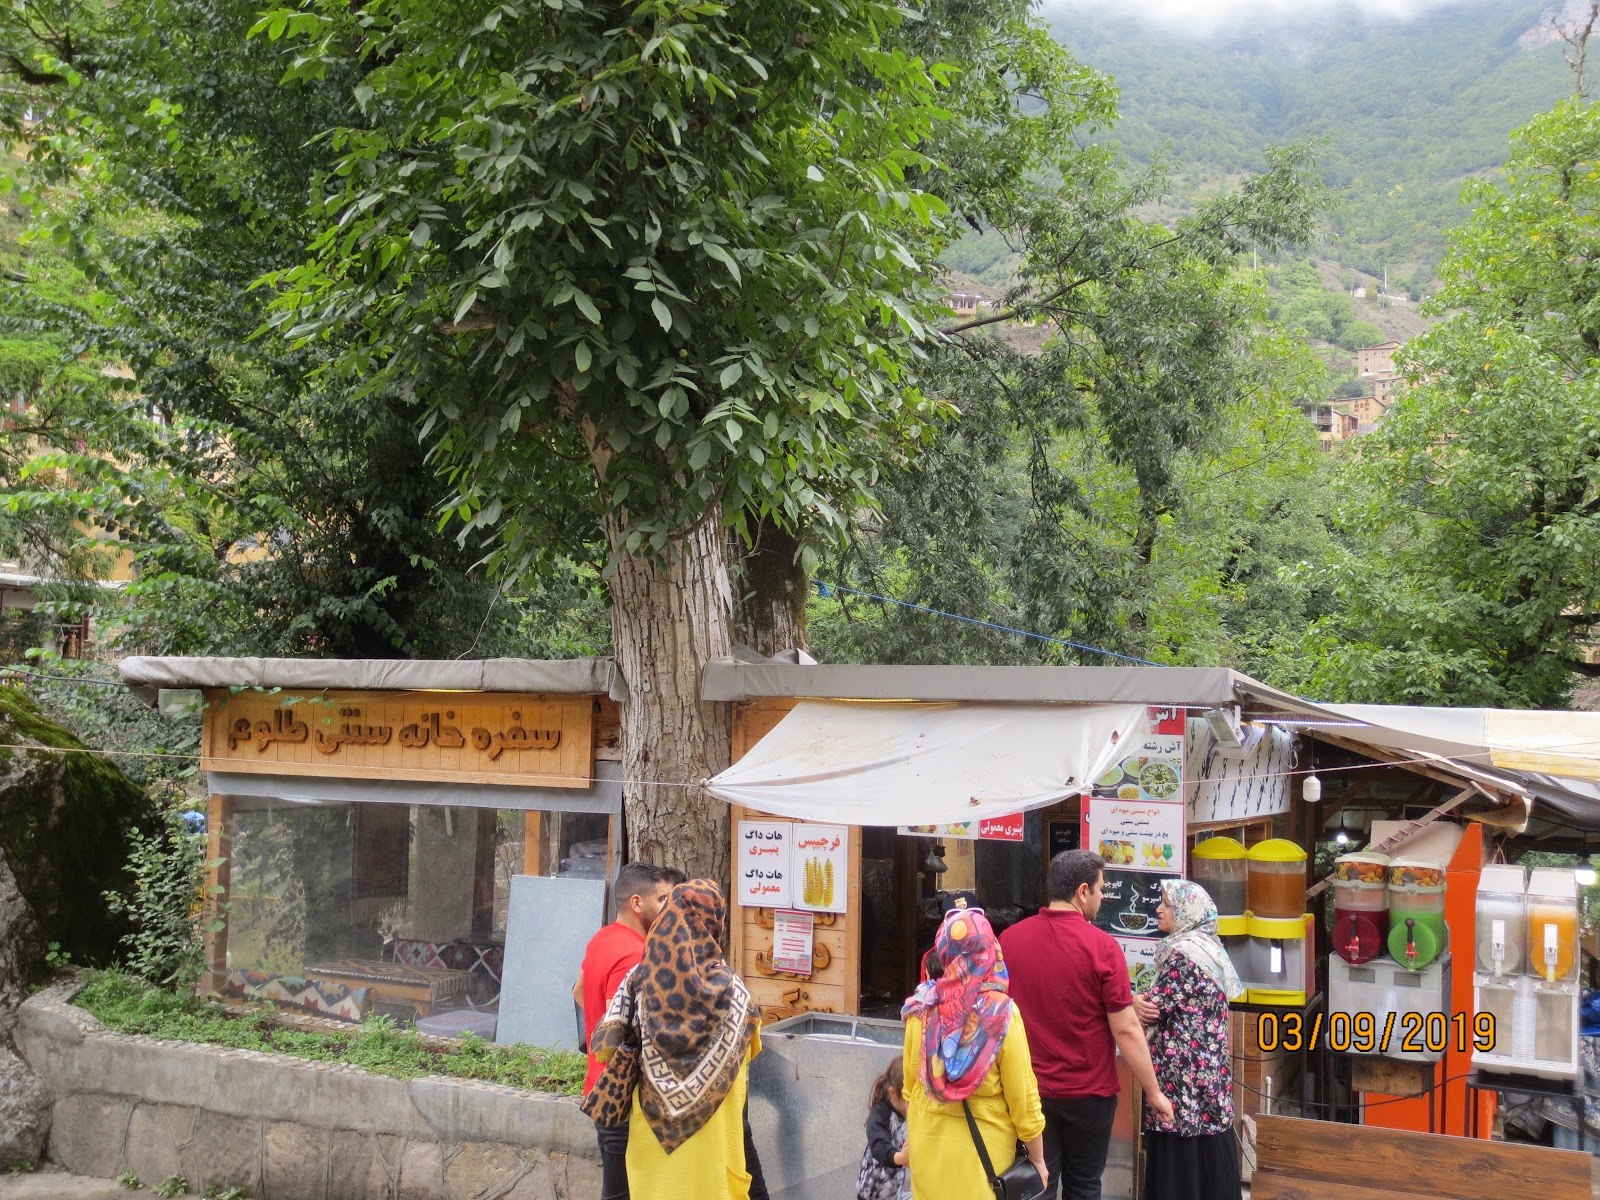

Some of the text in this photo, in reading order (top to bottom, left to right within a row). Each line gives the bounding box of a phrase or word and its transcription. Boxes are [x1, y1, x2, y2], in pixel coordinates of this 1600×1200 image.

[228, 708, 561, 762] سفره خانه سنتی طلوع
[1143, 741, 1182, 754] آش رشته
[980, 820, 1022, 837] پنیری معمولی
[765, 830, 783, 840] هات
[749, 844, 779, 856] پنیری
[765, 868, 783, 879] هات
[749, 882, 780, 894] معمولی
